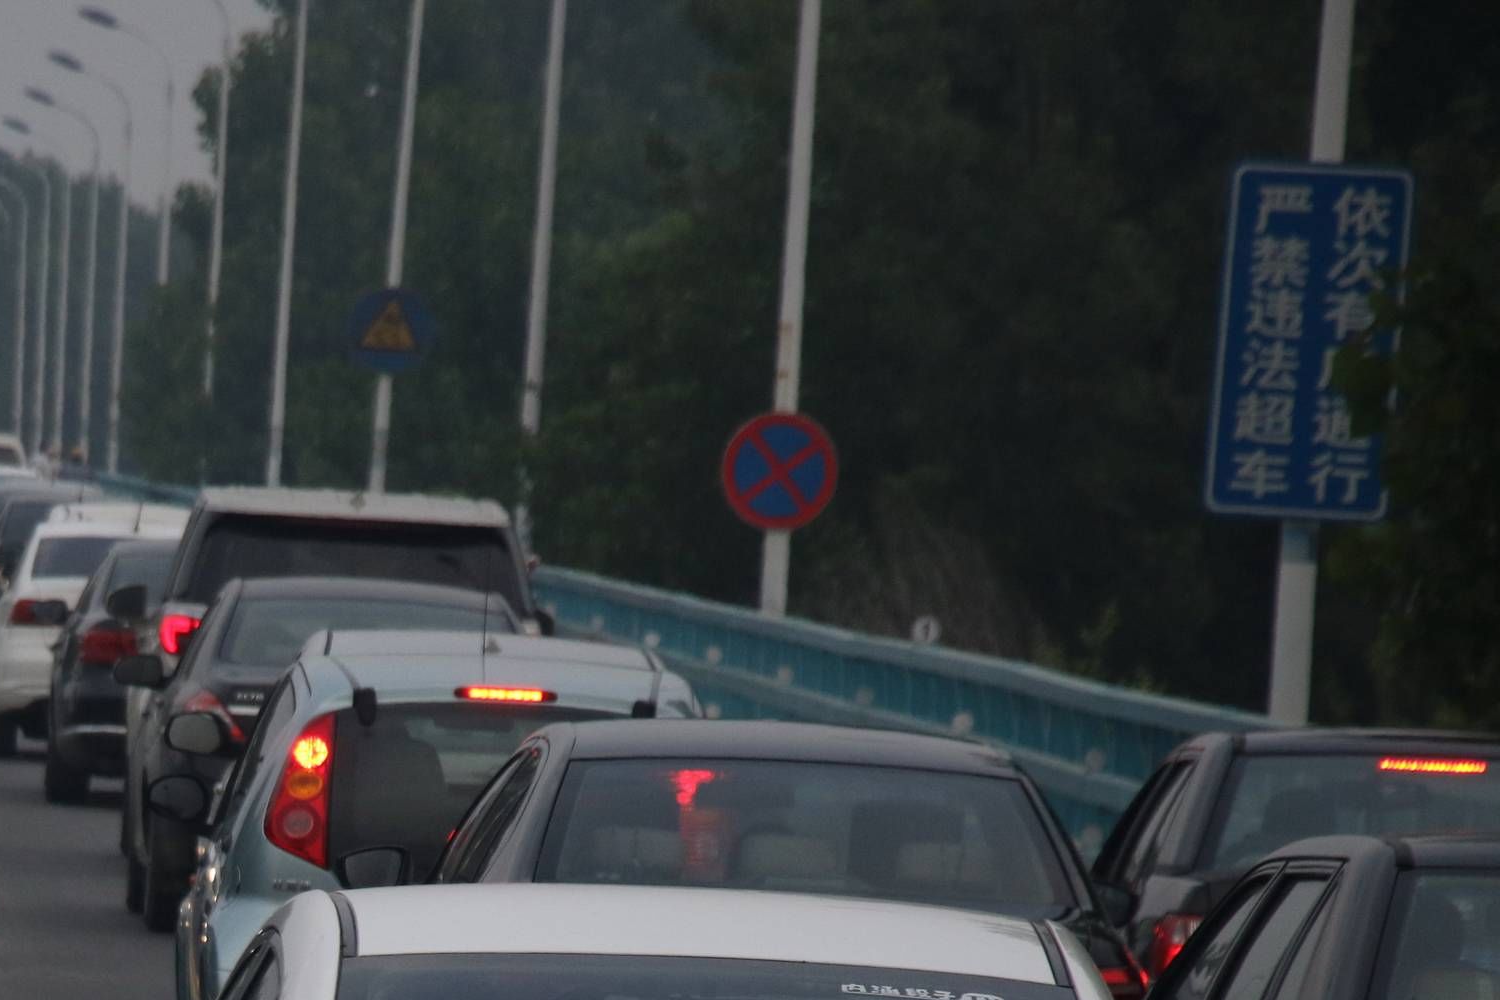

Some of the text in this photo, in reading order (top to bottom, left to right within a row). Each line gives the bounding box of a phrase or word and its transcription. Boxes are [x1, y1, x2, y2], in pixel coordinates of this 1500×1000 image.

[1229, 185, 1313, 498] 严禁违法超车
[1306, 186, 1393, 505] 依次有通行
